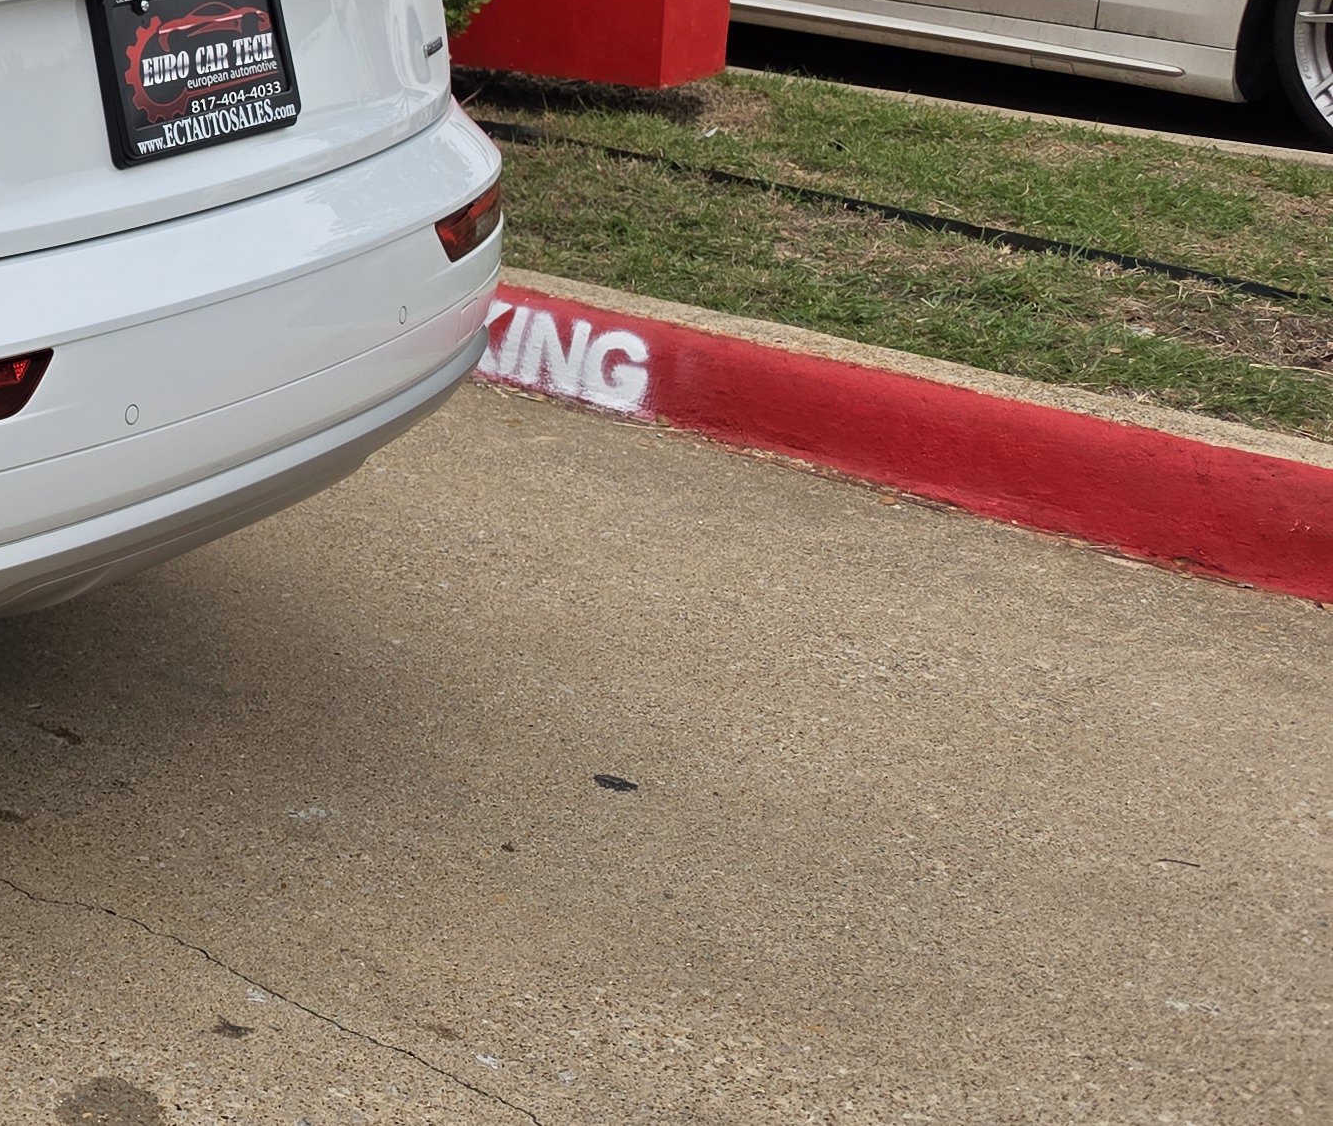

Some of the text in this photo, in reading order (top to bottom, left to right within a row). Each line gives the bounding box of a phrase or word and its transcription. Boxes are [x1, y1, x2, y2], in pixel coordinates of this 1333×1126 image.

[142, 32, 275, 87] EURO CAR TECH
[187, 60, 278, 90] european automotive
[191, 80, 282, 114] 817-404-4033
[137, 98, 297, 155] www.ECTAUTOSALES.com
